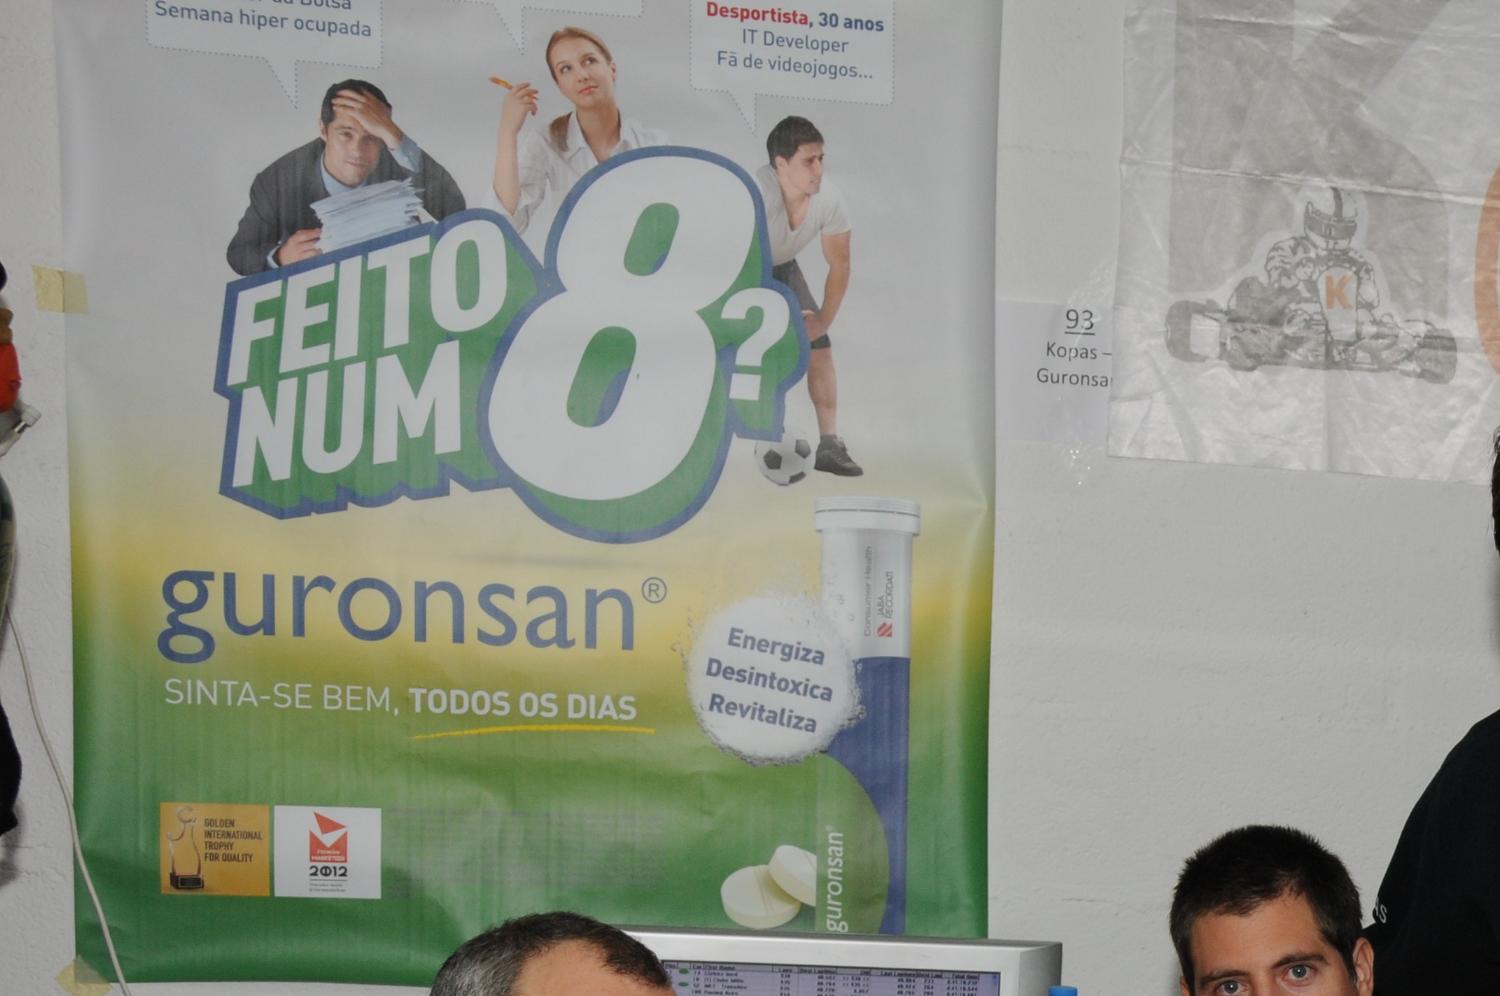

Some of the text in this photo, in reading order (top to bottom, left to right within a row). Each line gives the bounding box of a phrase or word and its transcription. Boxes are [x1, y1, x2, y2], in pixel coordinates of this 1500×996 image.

[155, 0, 372, 37] Semana hiper ocupada
[706, 1, 885, 32] Desportista, 30 anos
[742, 28, 849, 54] IT Developer
[743, 53, 764, 70] de
[228, 217, 508, 388] FEITO
[1325, 274, 1354, 311] K
[1065, 308, 1095, 331] 93
[1046, 341, 1097, 362] Kopas
[233, 338, 462, 488] NUM
[727, 626, 826, 666] Energiza
[705, 657, 833, 702] Desintoxica
[164, 677, 638, 721] SINTA-SE BEM, TODOS OS DIAS
[708, 693, 817, 734] Revitaliza
[204, 817, 235, 829] GOLDEN
[204, 830, 264, 840] INTERNATIONAL
[204, 841, 234, 851] TROPHY
[204, 853, 253, 863] FOR QUALITY
[309, 865, 348, 878] 2012
[826, 831, 849, 933] guronsan
